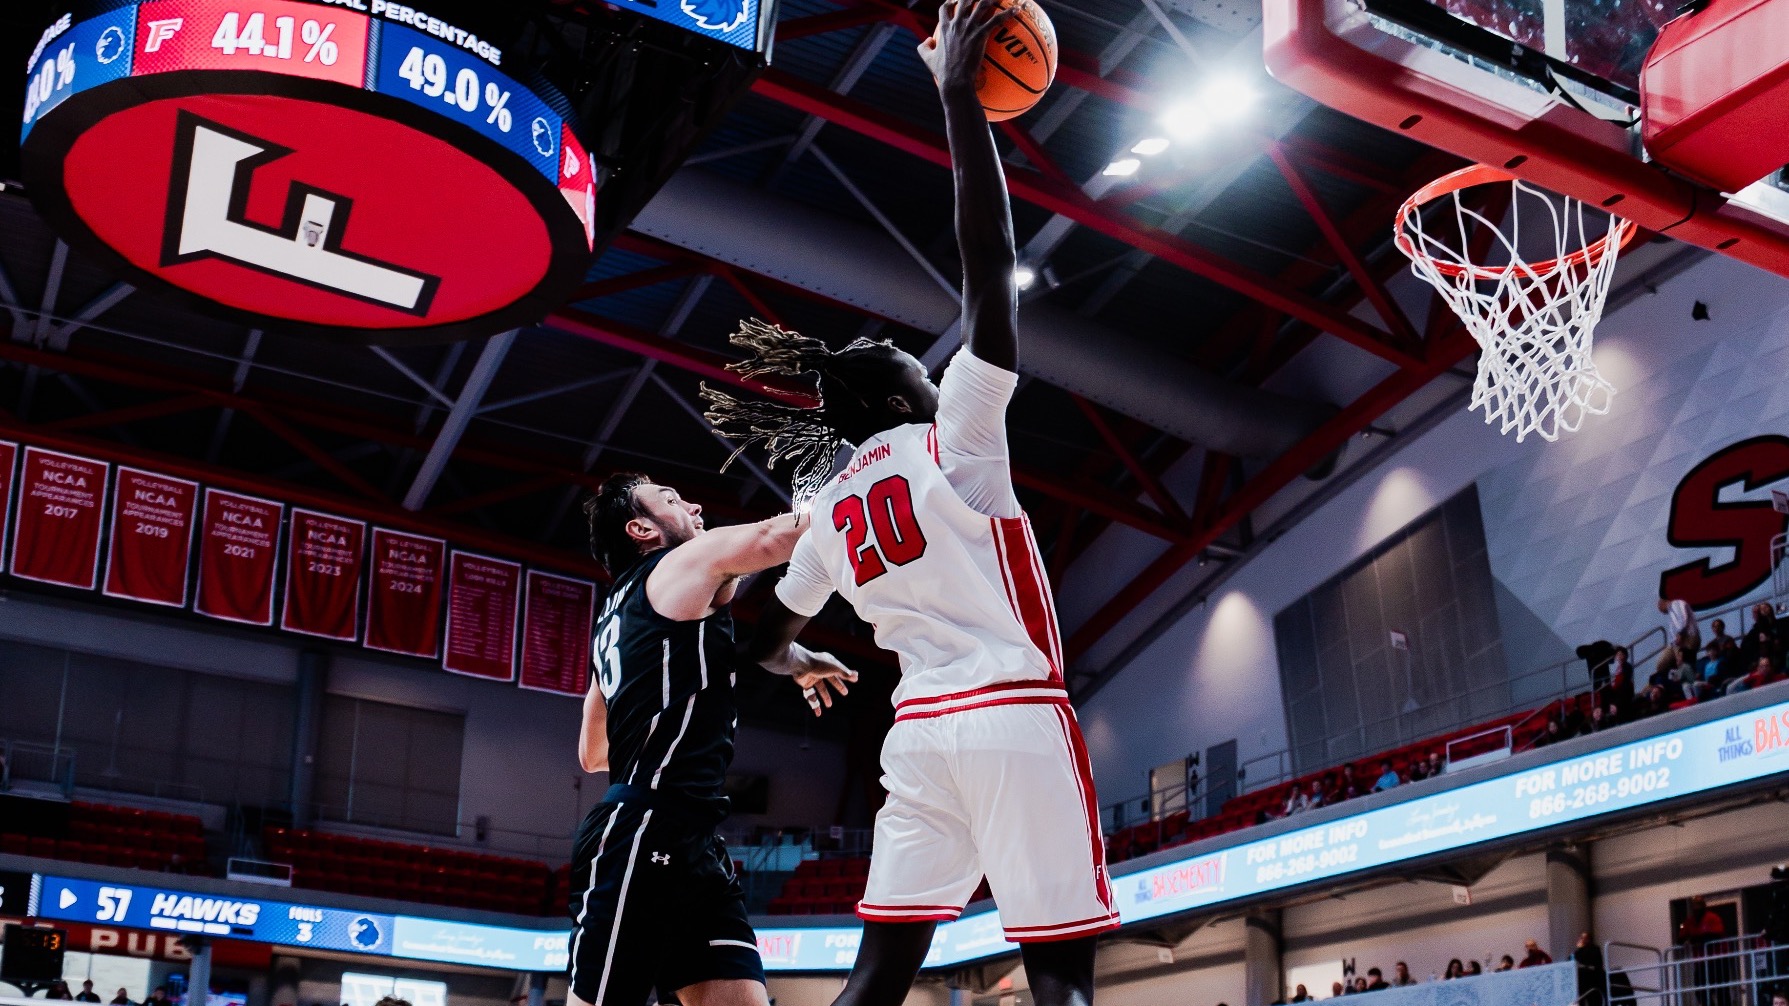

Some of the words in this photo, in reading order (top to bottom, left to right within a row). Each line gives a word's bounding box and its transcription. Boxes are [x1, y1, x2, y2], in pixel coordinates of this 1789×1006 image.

[371, 0, 502, 66] PERCENTAGE
[993, 26, 1029, 59] VO
[39, 458, 94, 475] VOLLEYBALL
[838, 443, 892, 485] BENJAMIN
[42, 470, 87, 488] NCAA
[134, 489, 176, 508] NCAA
[44, 504, 78, 519] 2017
[222, 511, 263, 528] NCAA
[135, 522, 169, 538] 2019
[832, 474, 928, 588] 20
[1659, 434, 1789, 612] S
[308, 530, 346, 547] NCAA
[223, 543, 255, 559] 2021
[389, 549, 426, 565] NCAA
[308, 561, 342, 577] 2023
[389, 580, 422, 594] 2024
[1725, 725, 1742, 744] ALL
[1717, 740, 1753, 764] THINGS
[1515, 770, 1556, 798] FOR
[1561, 753, 1623, 787] MORE
[1629, 738, 1683, 769] INFO
[1529, 767, 1670, 819] 866-268-9002
[1246, 843, 1277, 865] FOR
[1280, 829, 1325, 857] MORE
[1328, 819, 1369, 845] INFO
[96, 886, 133, 922] 57
[150, 893, 261, 926] HAWKS
[288, 906, 322, 922] FOULS
[296, 922, 313, 942] 3
